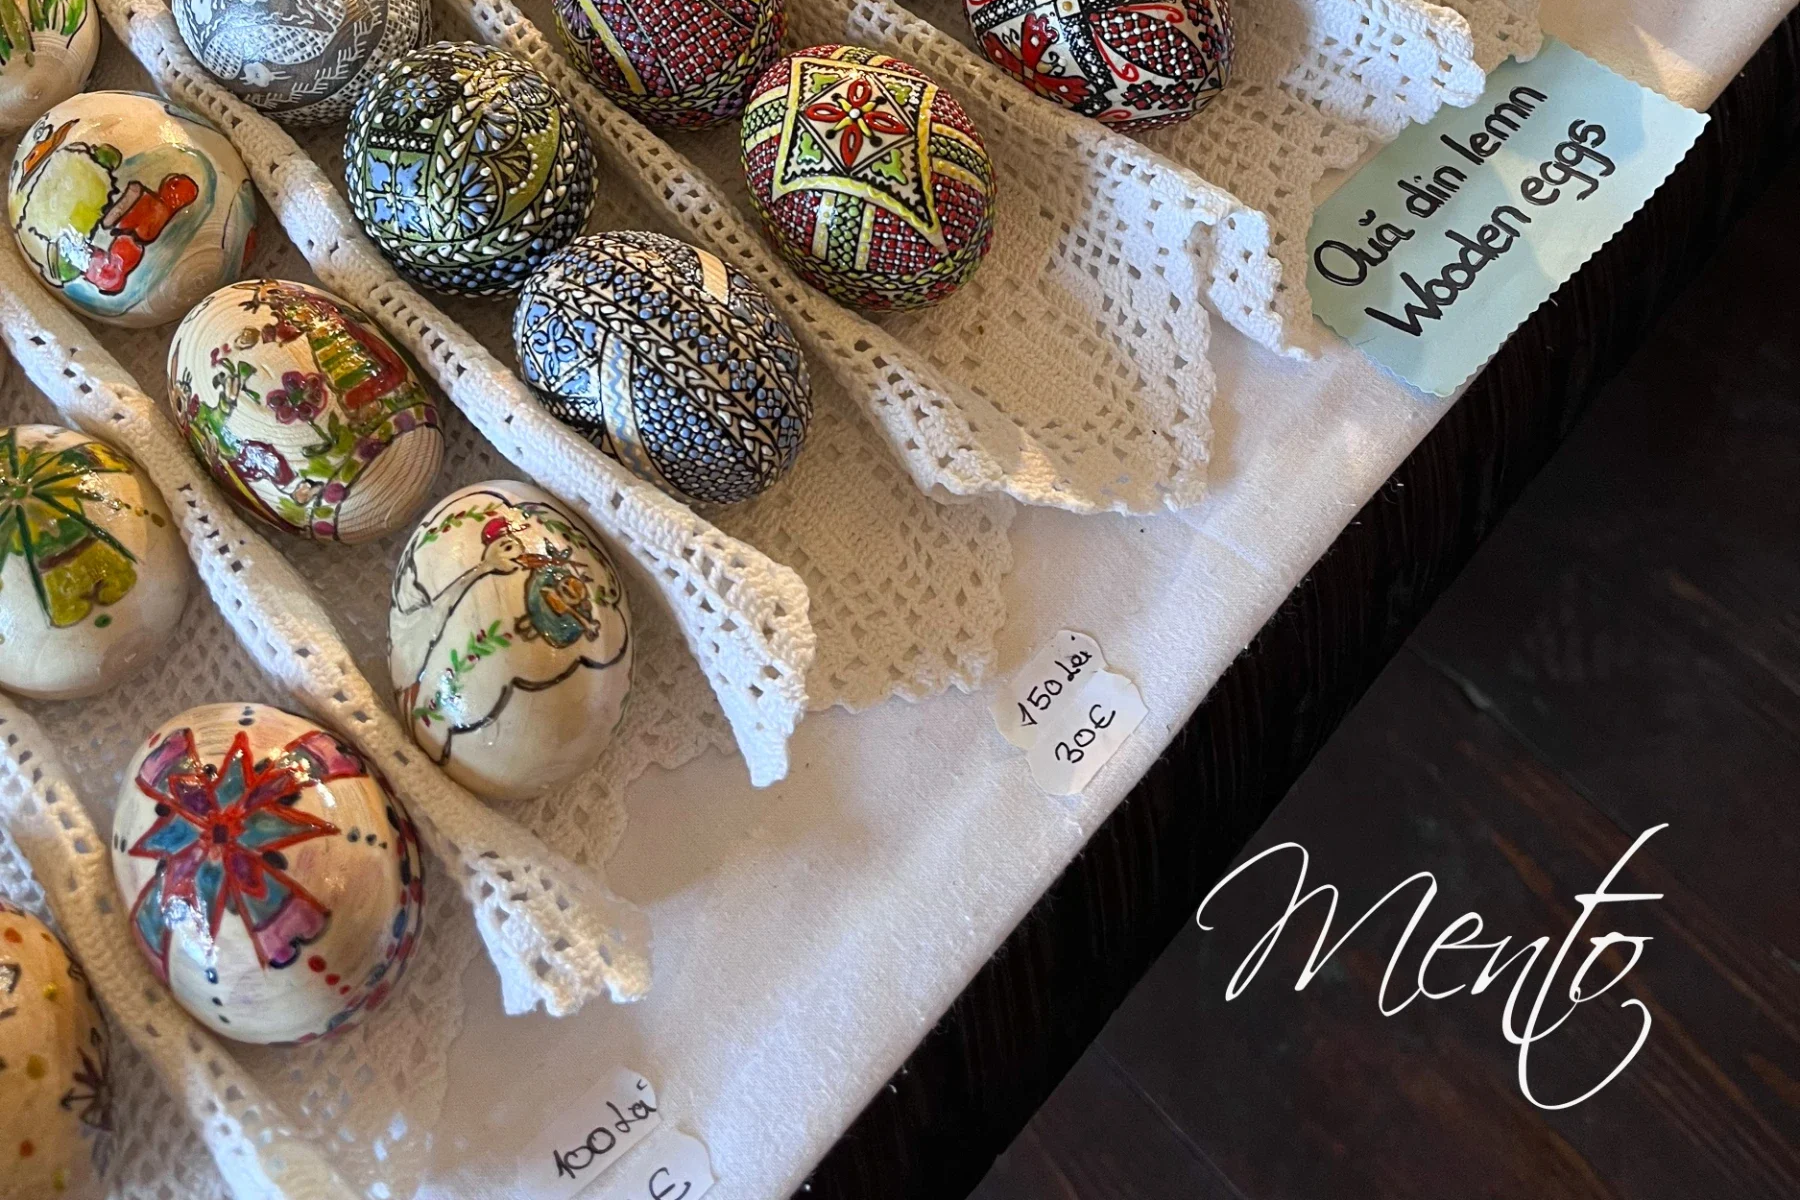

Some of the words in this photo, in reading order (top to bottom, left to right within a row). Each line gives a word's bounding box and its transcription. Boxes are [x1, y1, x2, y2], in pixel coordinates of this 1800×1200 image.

[1313, 208, 1415, 286] Ouă
[1397, 164, 1467, 218] din
[1440, 85, 1549, 166] lemn
[1363, 205, 1532, 337] Wooden
[1520, 118, 1616, 206] eggs
[1017, 679, 1063, 727] 150
[1054, 703, 1117, 764] 30€
[553, 1126, 616, 1179] 100
